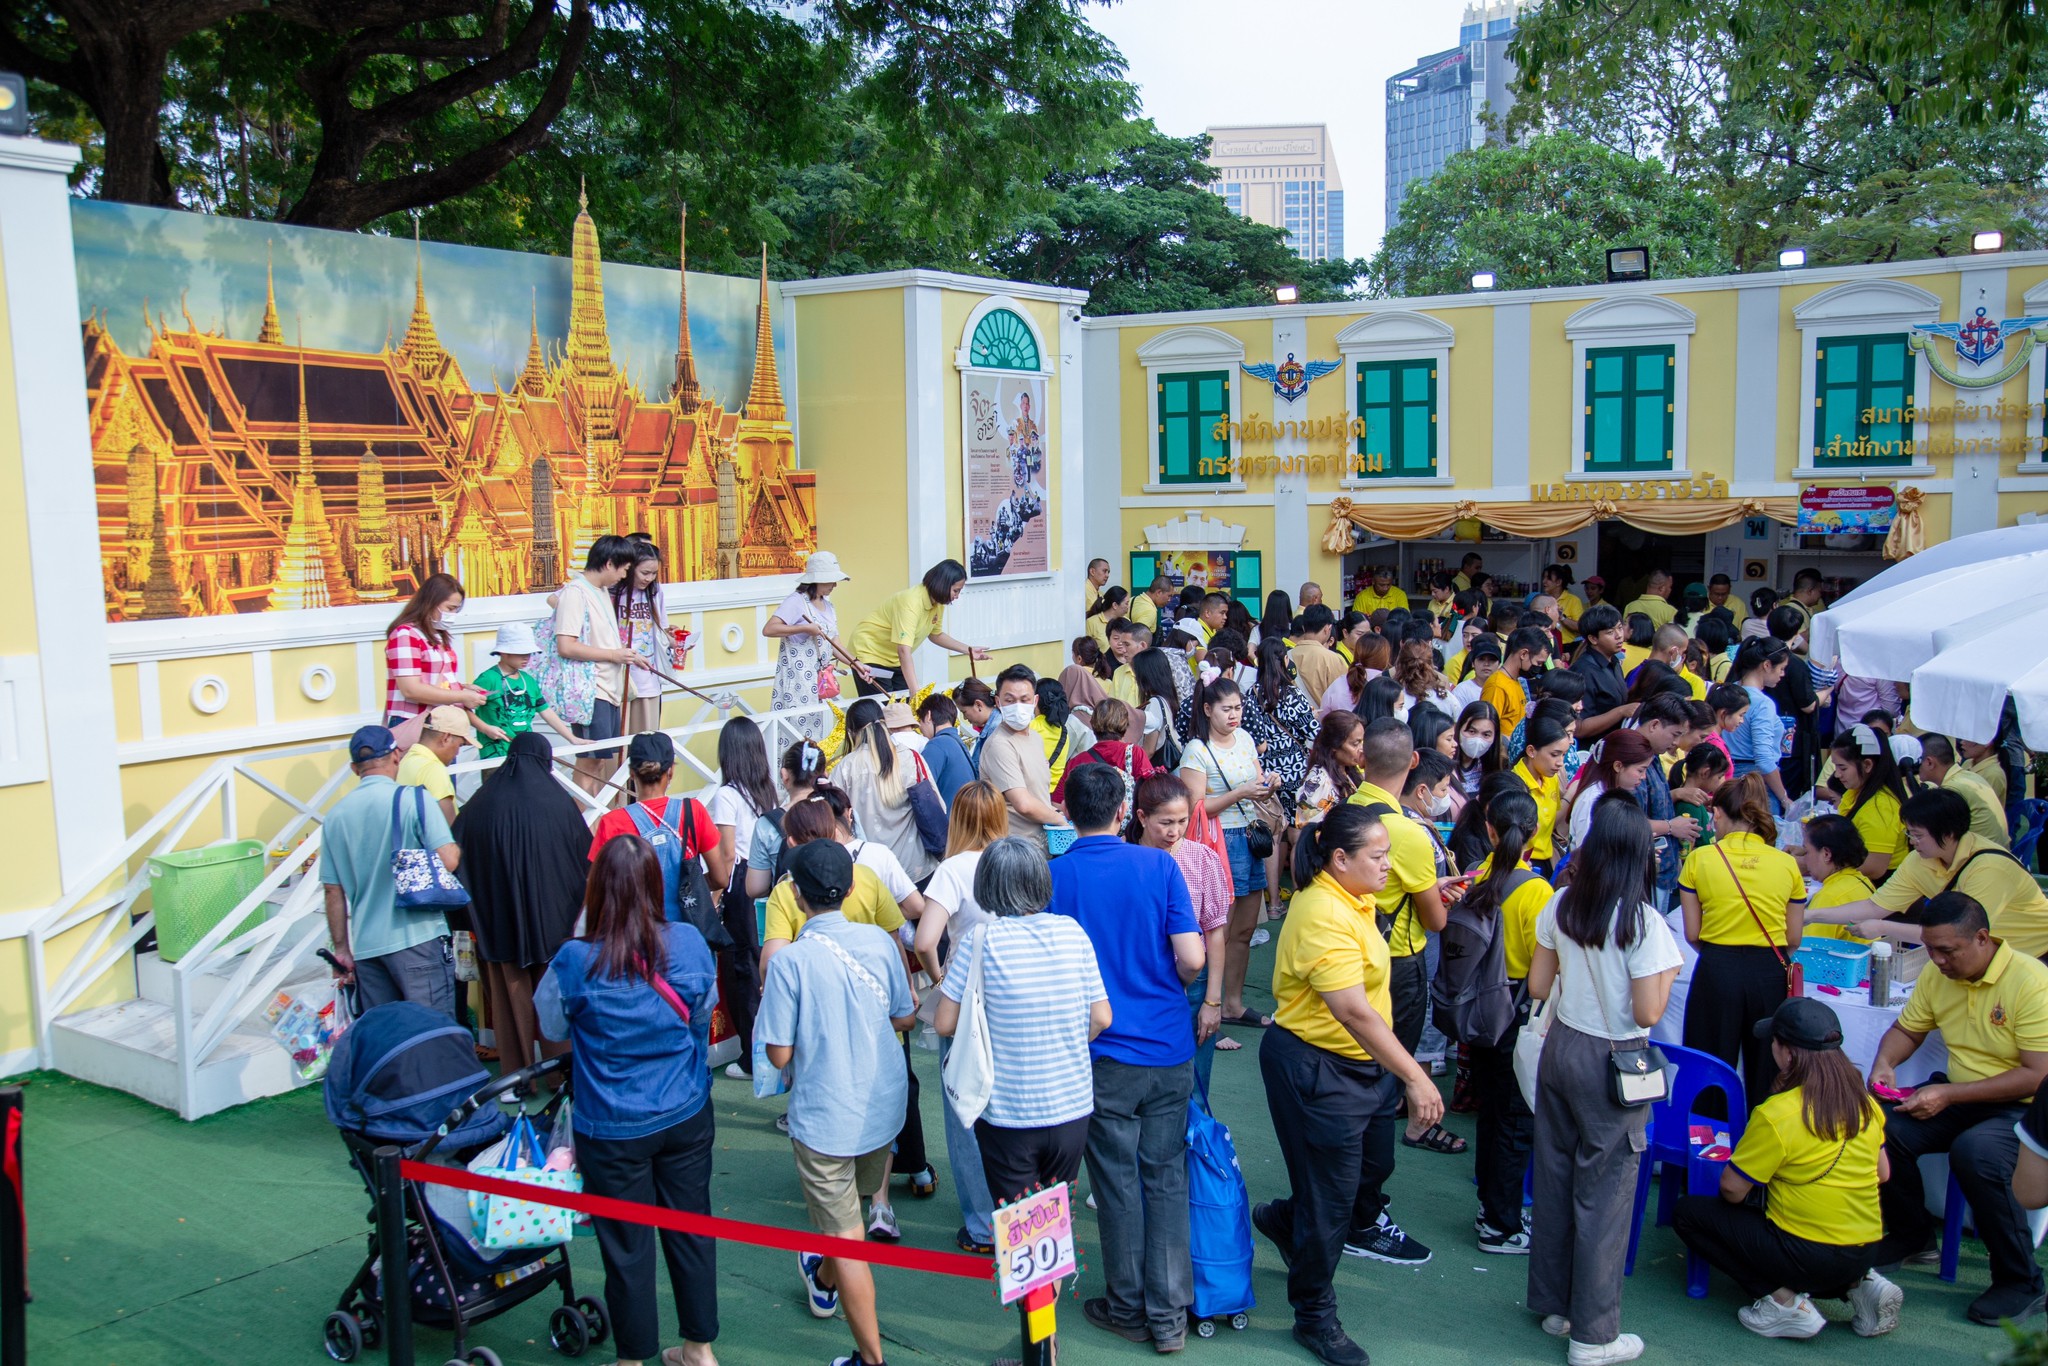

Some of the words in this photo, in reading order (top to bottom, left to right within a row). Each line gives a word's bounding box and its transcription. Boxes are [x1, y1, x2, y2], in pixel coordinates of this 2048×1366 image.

[1212, 411, 1366, 442] สำนักงานปลัด
[1199, 441, 1383, 476] กระทรวงกลาโหม
[1530, 472, 1729, 502] แลกของรางวัล
